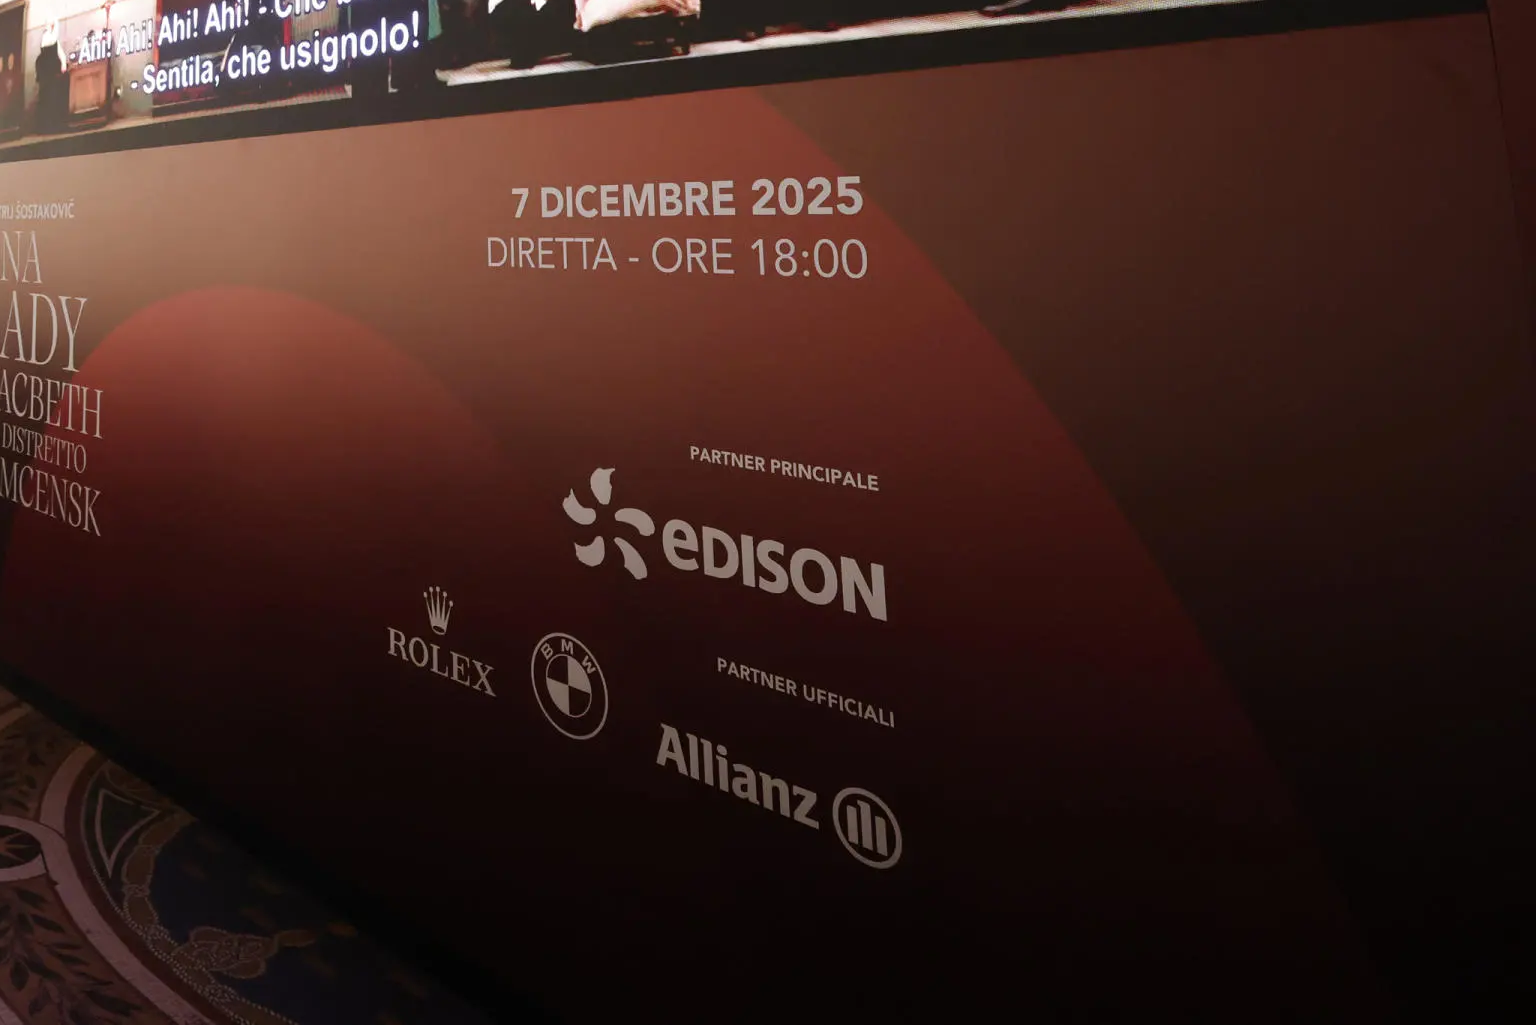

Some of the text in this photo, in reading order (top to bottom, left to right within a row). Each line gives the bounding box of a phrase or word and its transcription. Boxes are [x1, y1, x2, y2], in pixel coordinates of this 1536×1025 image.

[78, 29, 112, 64] Ahi!
[116, 18, 153, 55] Ahi!
[158, 7, 199, 46] Ahi!
[142, 54, 220, 94] Sentila,
[227, 45, 272, 79] che
[280, 11, 419, 73] usignolo!
[511, 176, 864, 218] 7 DICEMBRE 2025
[487, 237, 617, 271] DIRETTA
[652, 237, 734, 274] ORE
[751, 238, 867, 279] 18:00
[2, 422, 87, 474] DISTRETTO
[690, 446, 880, 492] PARTNER PRINCIPALE
[387, 627, 497, 697] ROLEX
[540, 638, 597, 675] BMW
[717, 657, 895, 728] PARTNER UFFICIALI
[656, 722, 819, 830] Allianz
